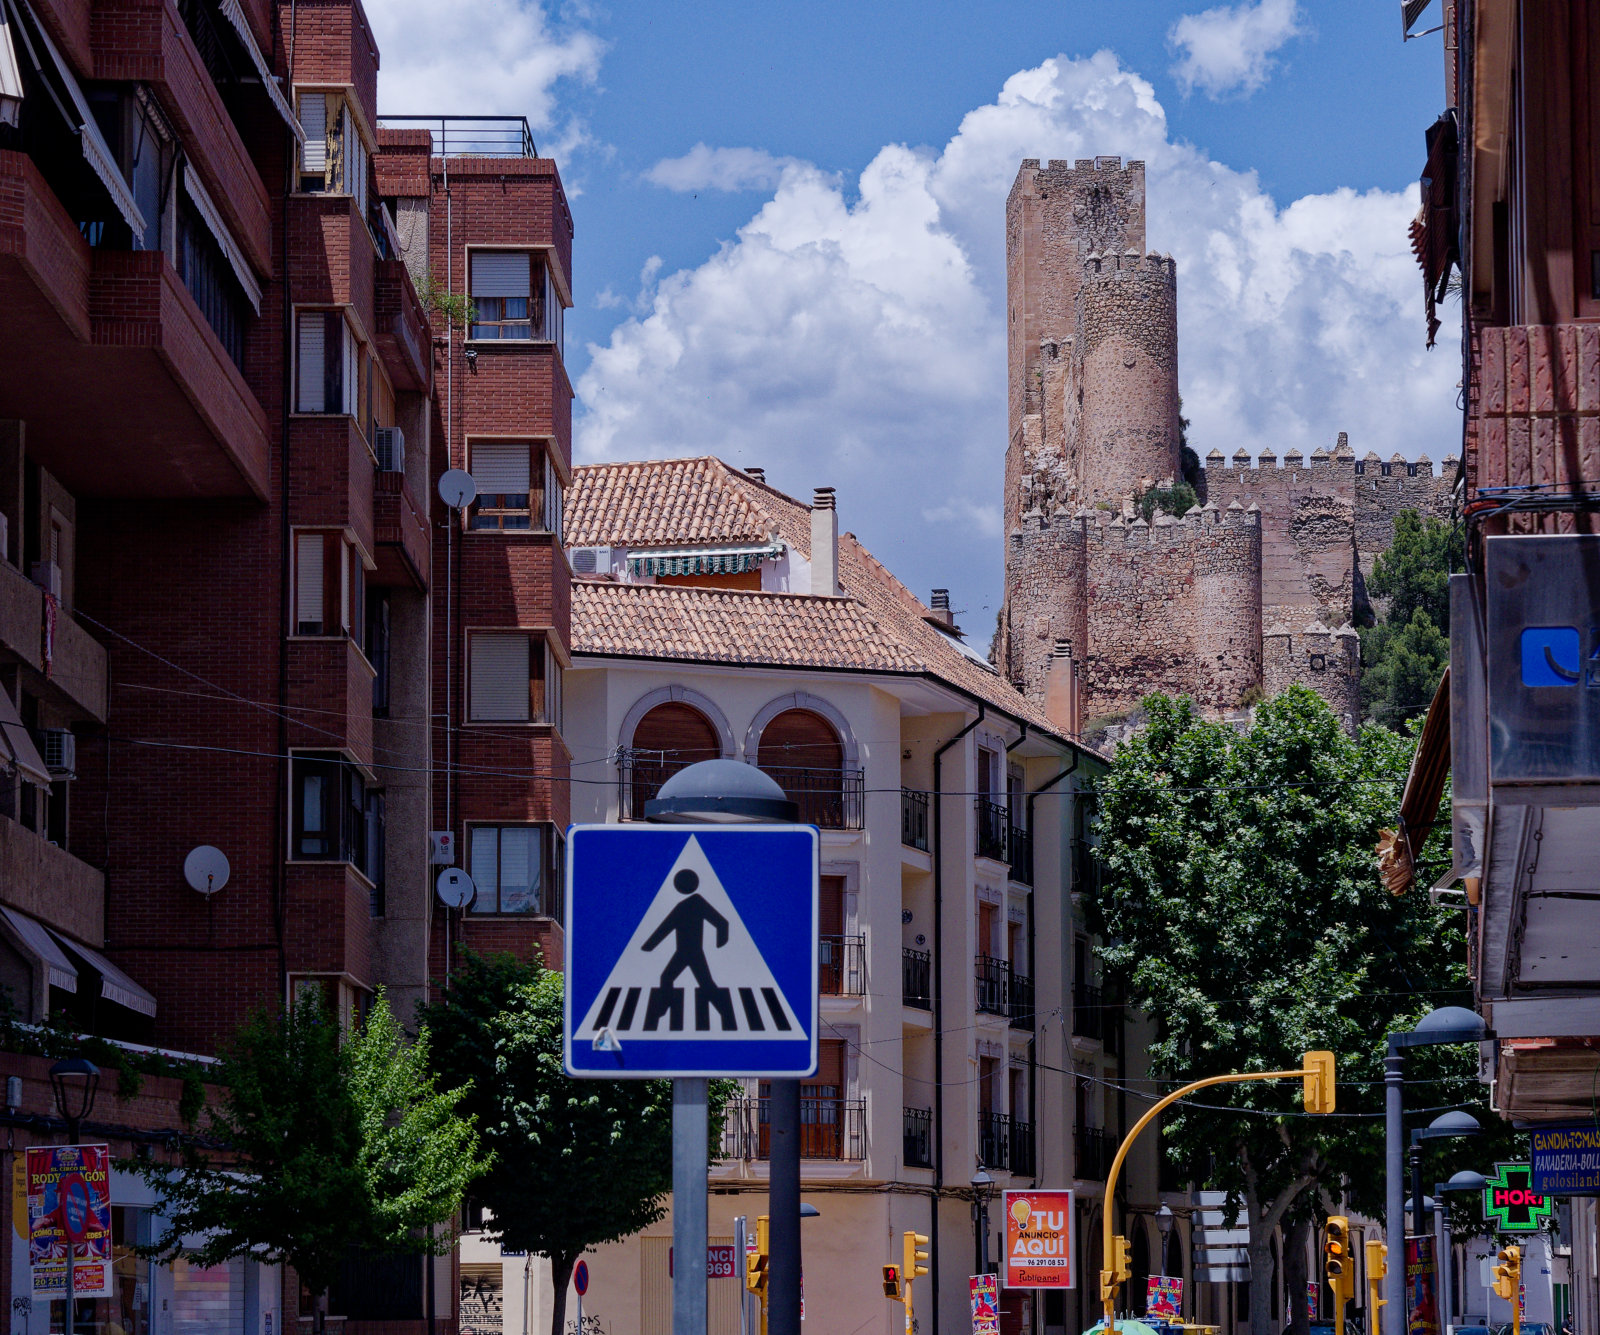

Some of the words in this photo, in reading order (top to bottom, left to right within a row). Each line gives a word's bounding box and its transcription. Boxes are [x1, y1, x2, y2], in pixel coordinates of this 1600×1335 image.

[32, 1173, 61, 1184] RODY
[1031, 1211, 1064, 1231] TU
[1018, 1231, 1059, 1239] ANUNCIO
[1012, 1235, 1064, 1255] AQUÍ
[707, 1262, 732, 1275] 969
[35, 1278, 47, 1286] 20
[1019, 1269, 1060, 1283] Publipanel
